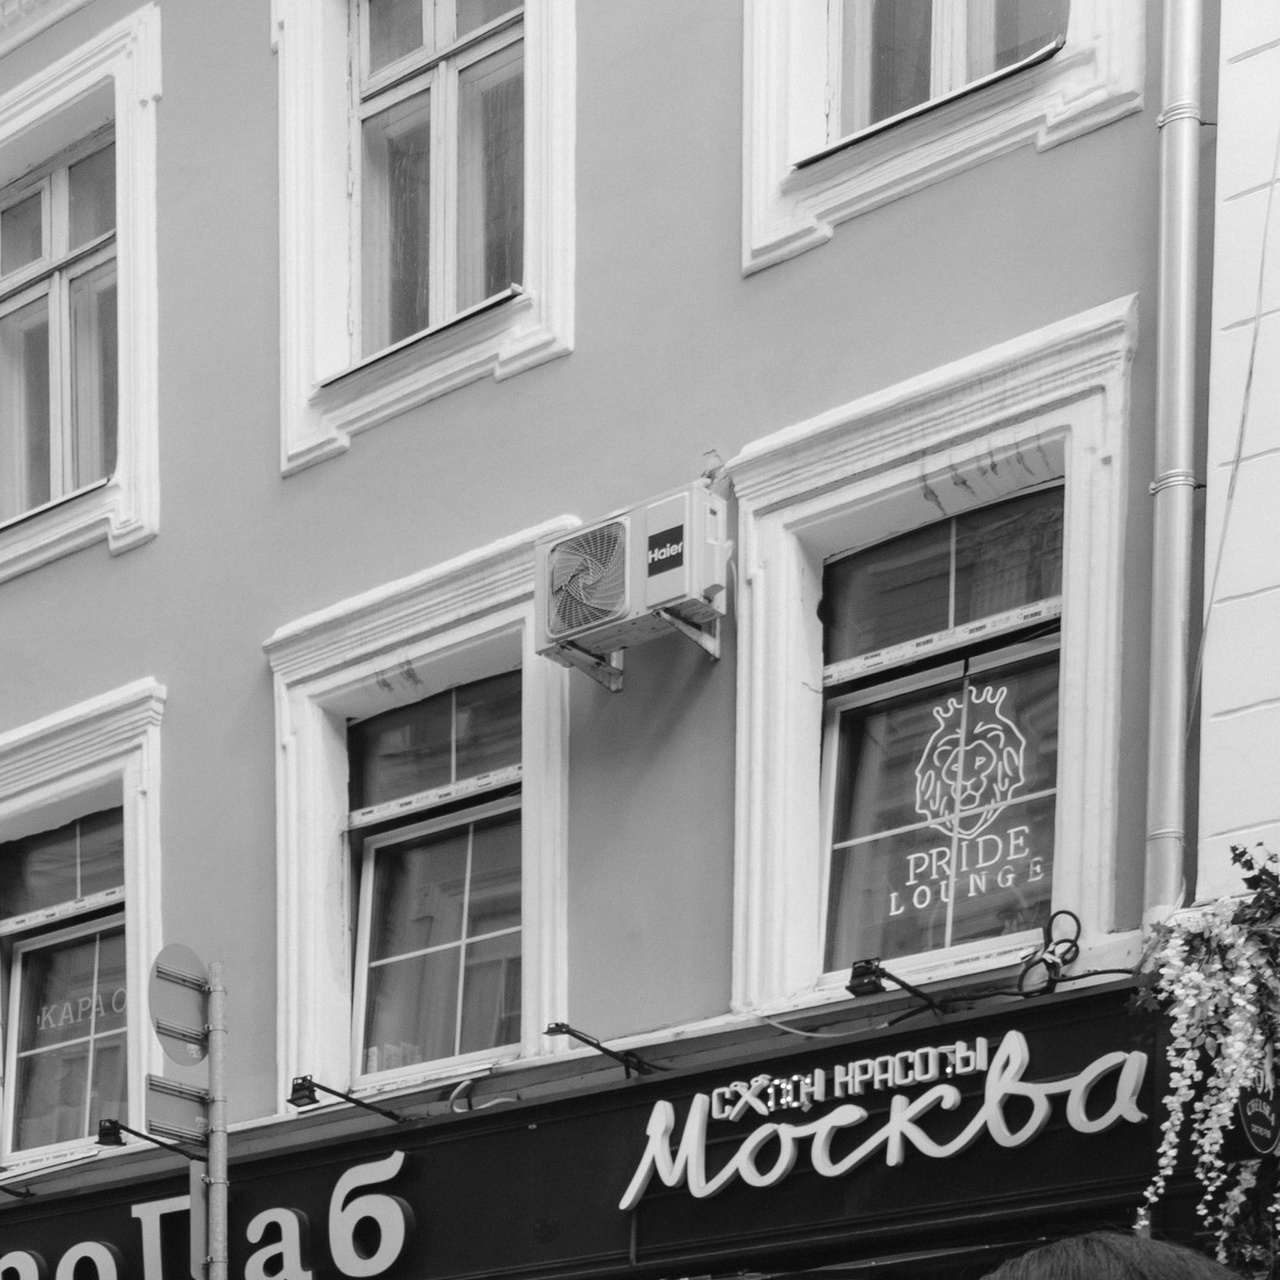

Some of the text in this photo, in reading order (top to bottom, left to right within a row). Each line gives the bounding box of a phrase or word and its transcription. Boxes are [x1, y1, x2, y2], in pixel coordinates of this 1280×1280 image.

[648, 541, 683, 564] Haier
[905, 826, 1030, 886] PRIDE
[889, 857, 1044, 916] LOUNGE
[834, 1036, 989, 1098] КРАСОТЫ
[619, 1030, 1149, 1211] Москва
